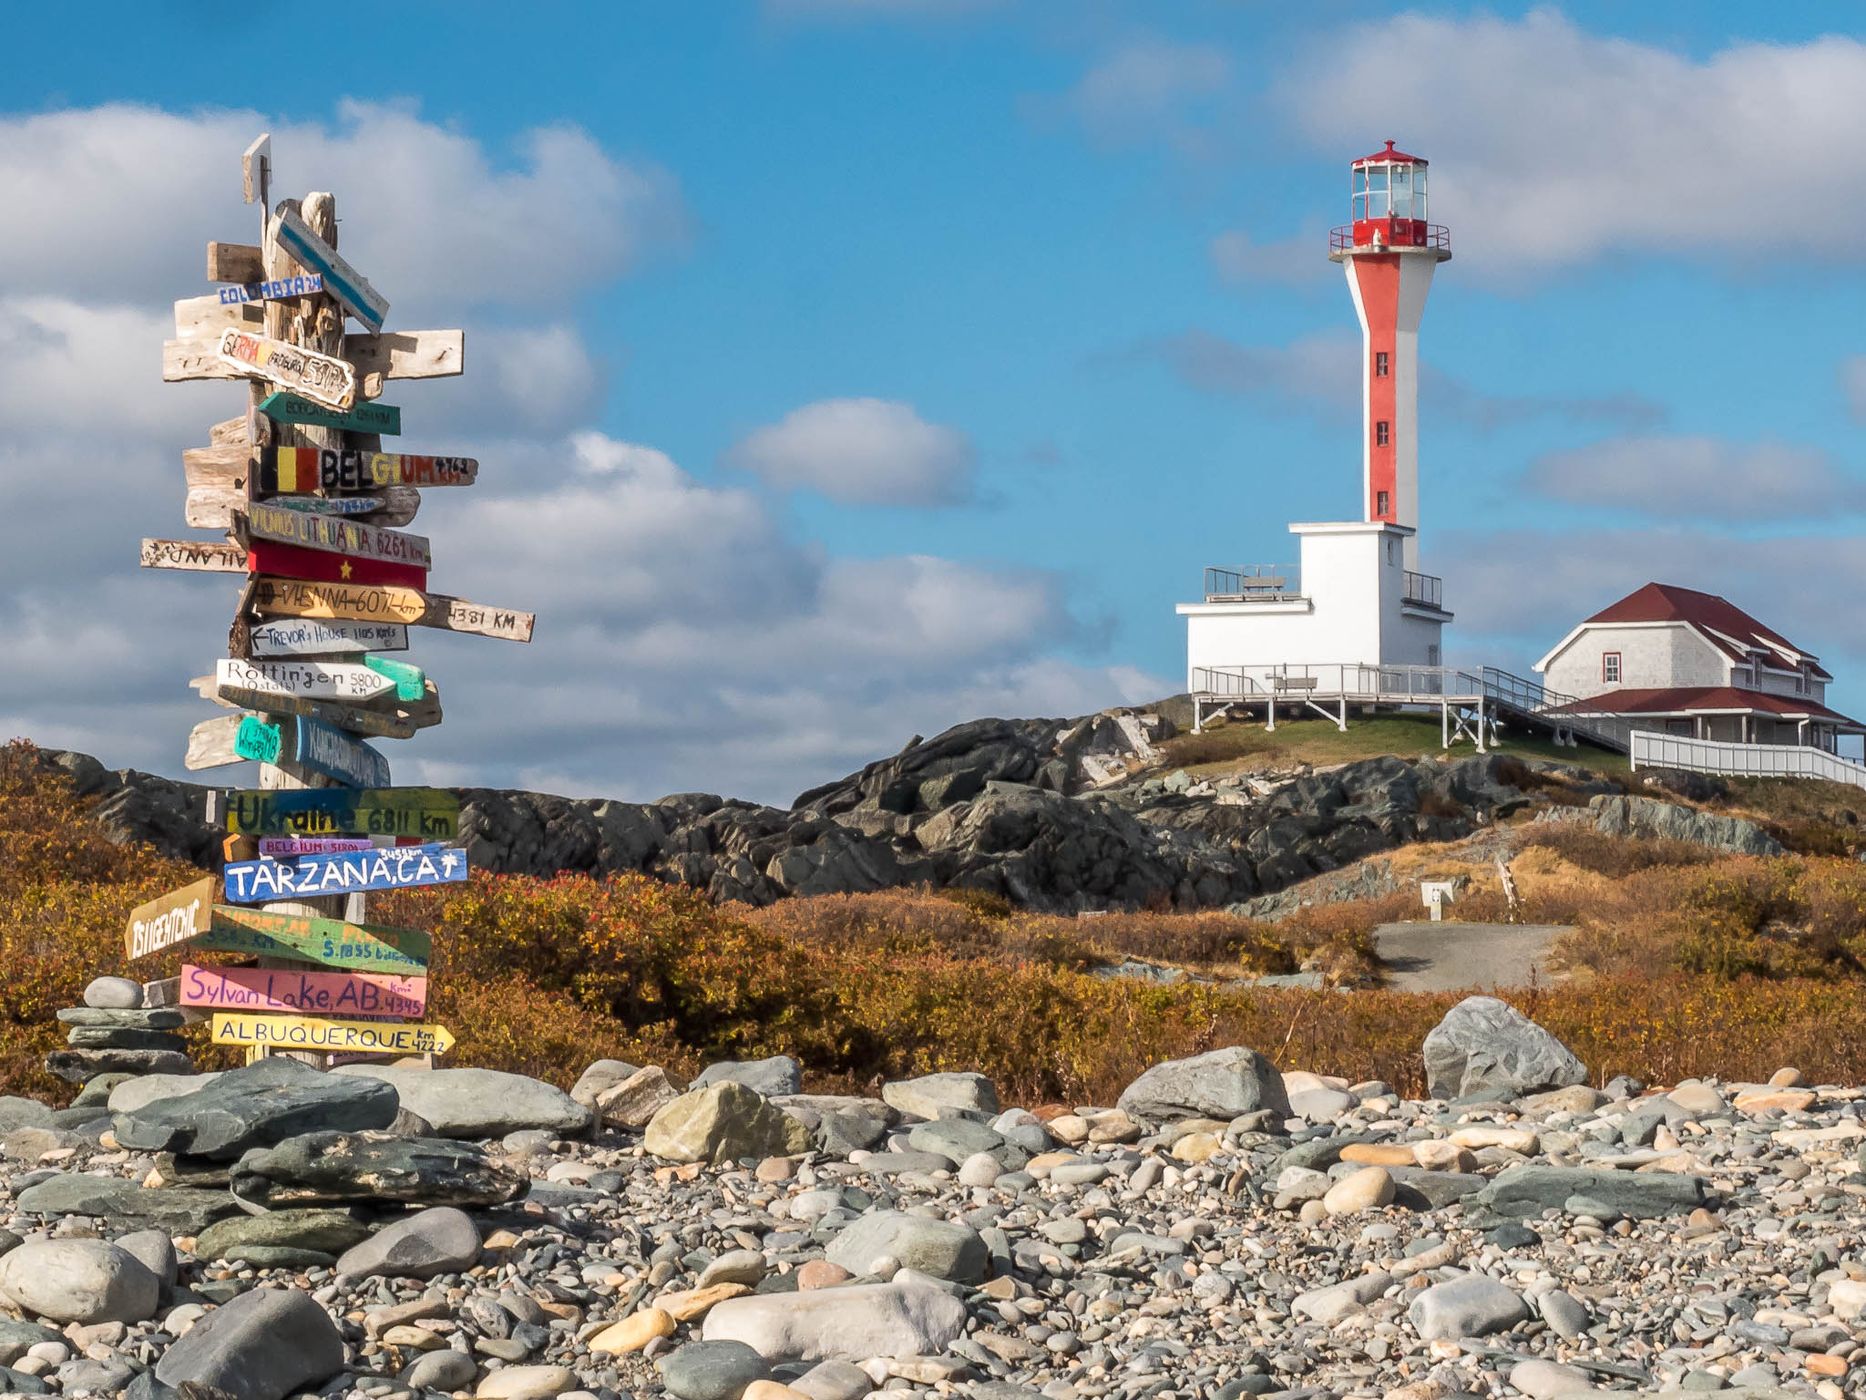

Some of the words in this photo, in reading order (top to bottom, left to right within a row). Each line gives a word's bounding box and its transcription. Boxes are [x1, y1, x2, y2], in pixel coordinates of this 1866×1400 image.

[321, 449, 434, 488] BELGIUM
[299, 516, 372, 553] LITHUANIA
[377, 532, 407, 559] 6261
[493, 612, 516, 630] KM
[350, 674, 382, 689] 5800
[237, 794, 356, 832] Ukraine
[368, 808, 409, 833] 6811
[419, 810, 450, 836] km
[266, 841, 323, 854] BELGIUM
[186, 968, 259, 1007] Sylvan
[265, 974, 333, 1012] Lake,
[220, 1021, 412, 1049] ALBUQUERQUE
[416, 1028, 435, 1040] km
[411, 1038, 445, 1053] 4222
